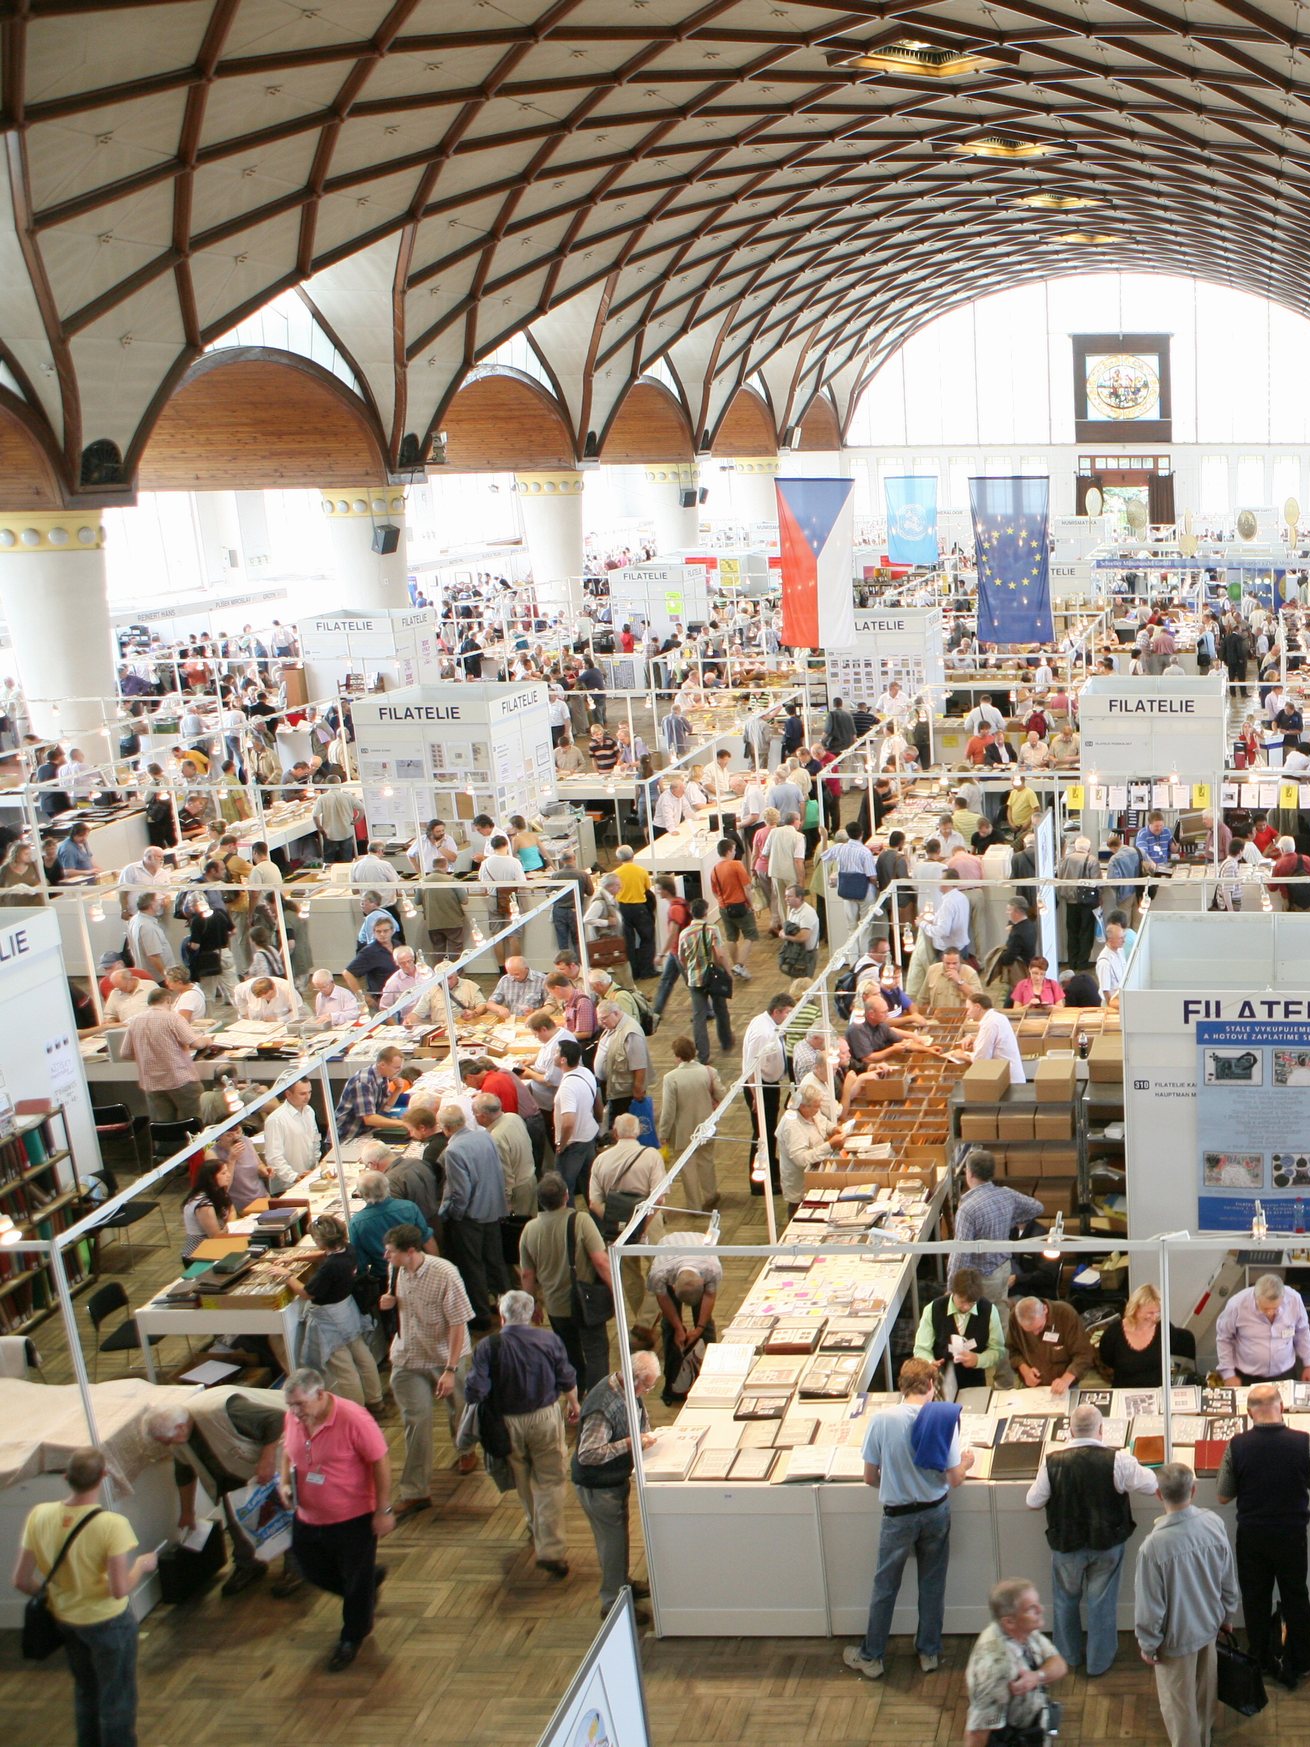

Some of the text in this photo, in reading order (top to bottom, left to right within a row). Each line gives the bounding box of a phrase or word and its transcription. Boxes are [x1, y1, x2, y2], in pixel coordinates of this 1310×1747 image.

[623, 571, 668, 581] FILATELIE
[401, 613, 428, 627] FILATELIE
[316, 621, 373, 631] FILATELIE
[855, 620, 905, 631] LATELIE
[502, 690, 538, 715] FILATELIE
[1109, 699, 1195, 713] FILATELIE
[379, 706, 461, 721] FILATELIE
[1225, 1025, 1251, 1033] STÁLE
[1213, 1032, 1249, 1040] HOTOVÉ
[1251, 1032, 1299, 1041] ZAPLATÍME
[1134, 1081, 1149, 1089] 310
